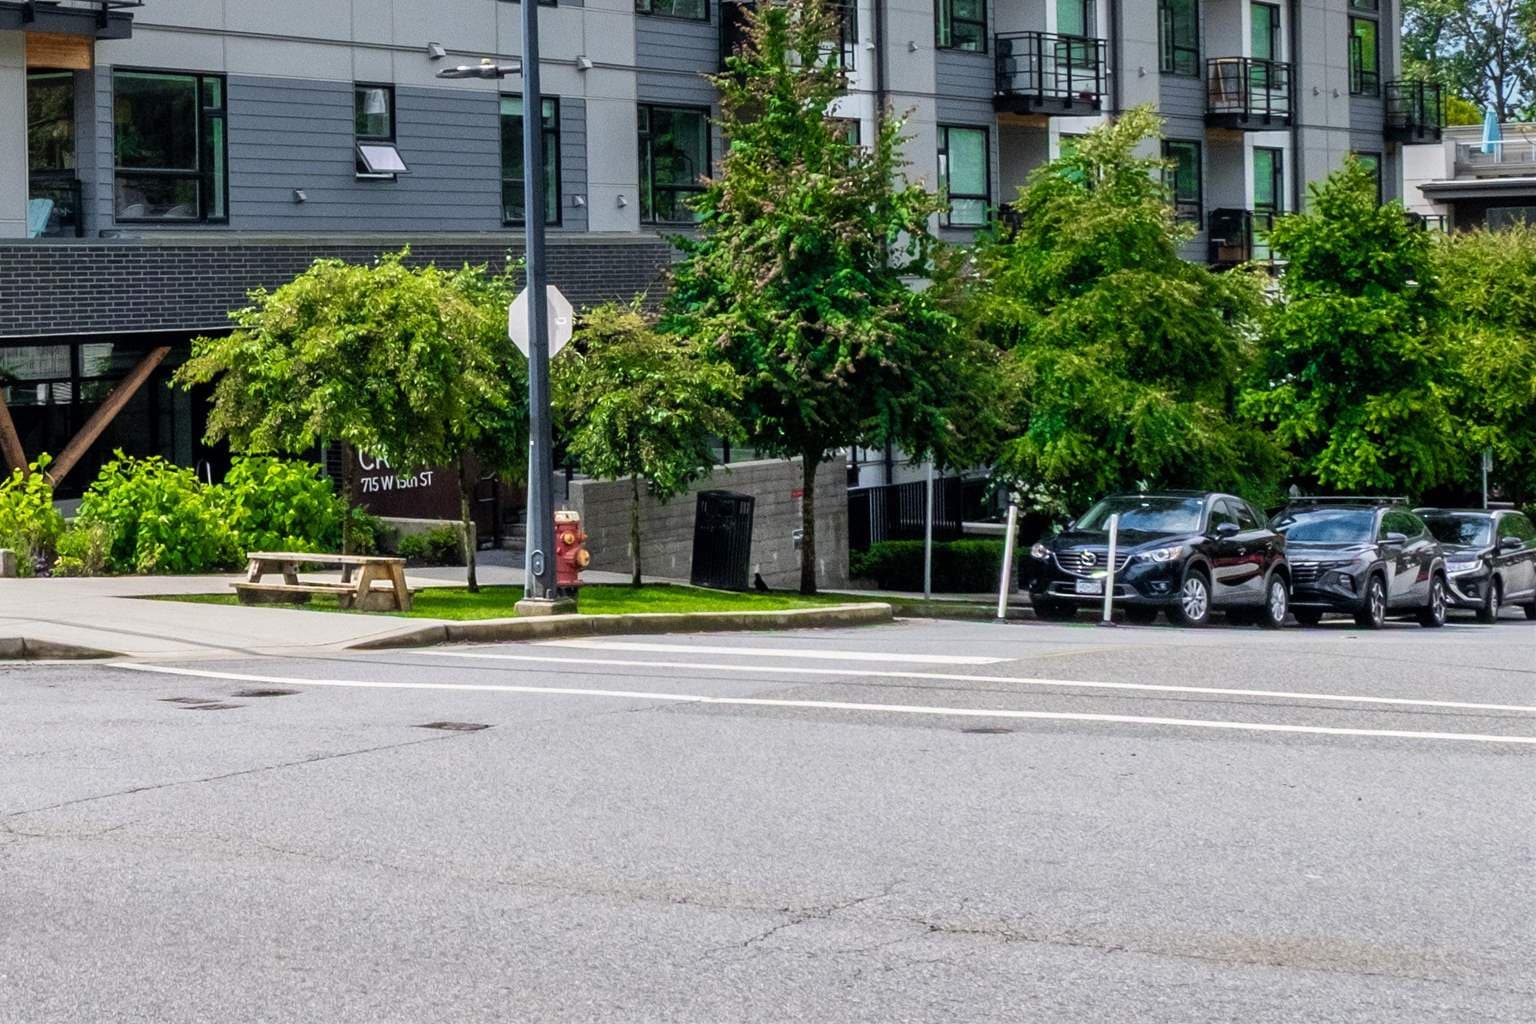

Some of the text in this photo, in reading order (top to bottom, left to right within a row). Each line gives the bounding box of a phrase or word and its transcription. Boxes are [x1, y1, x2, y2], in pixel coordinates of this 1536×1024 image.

[360, 477, 379, 492] 715
[381, 476, 393, 490] W
[420, 471, 433, 486] ST
